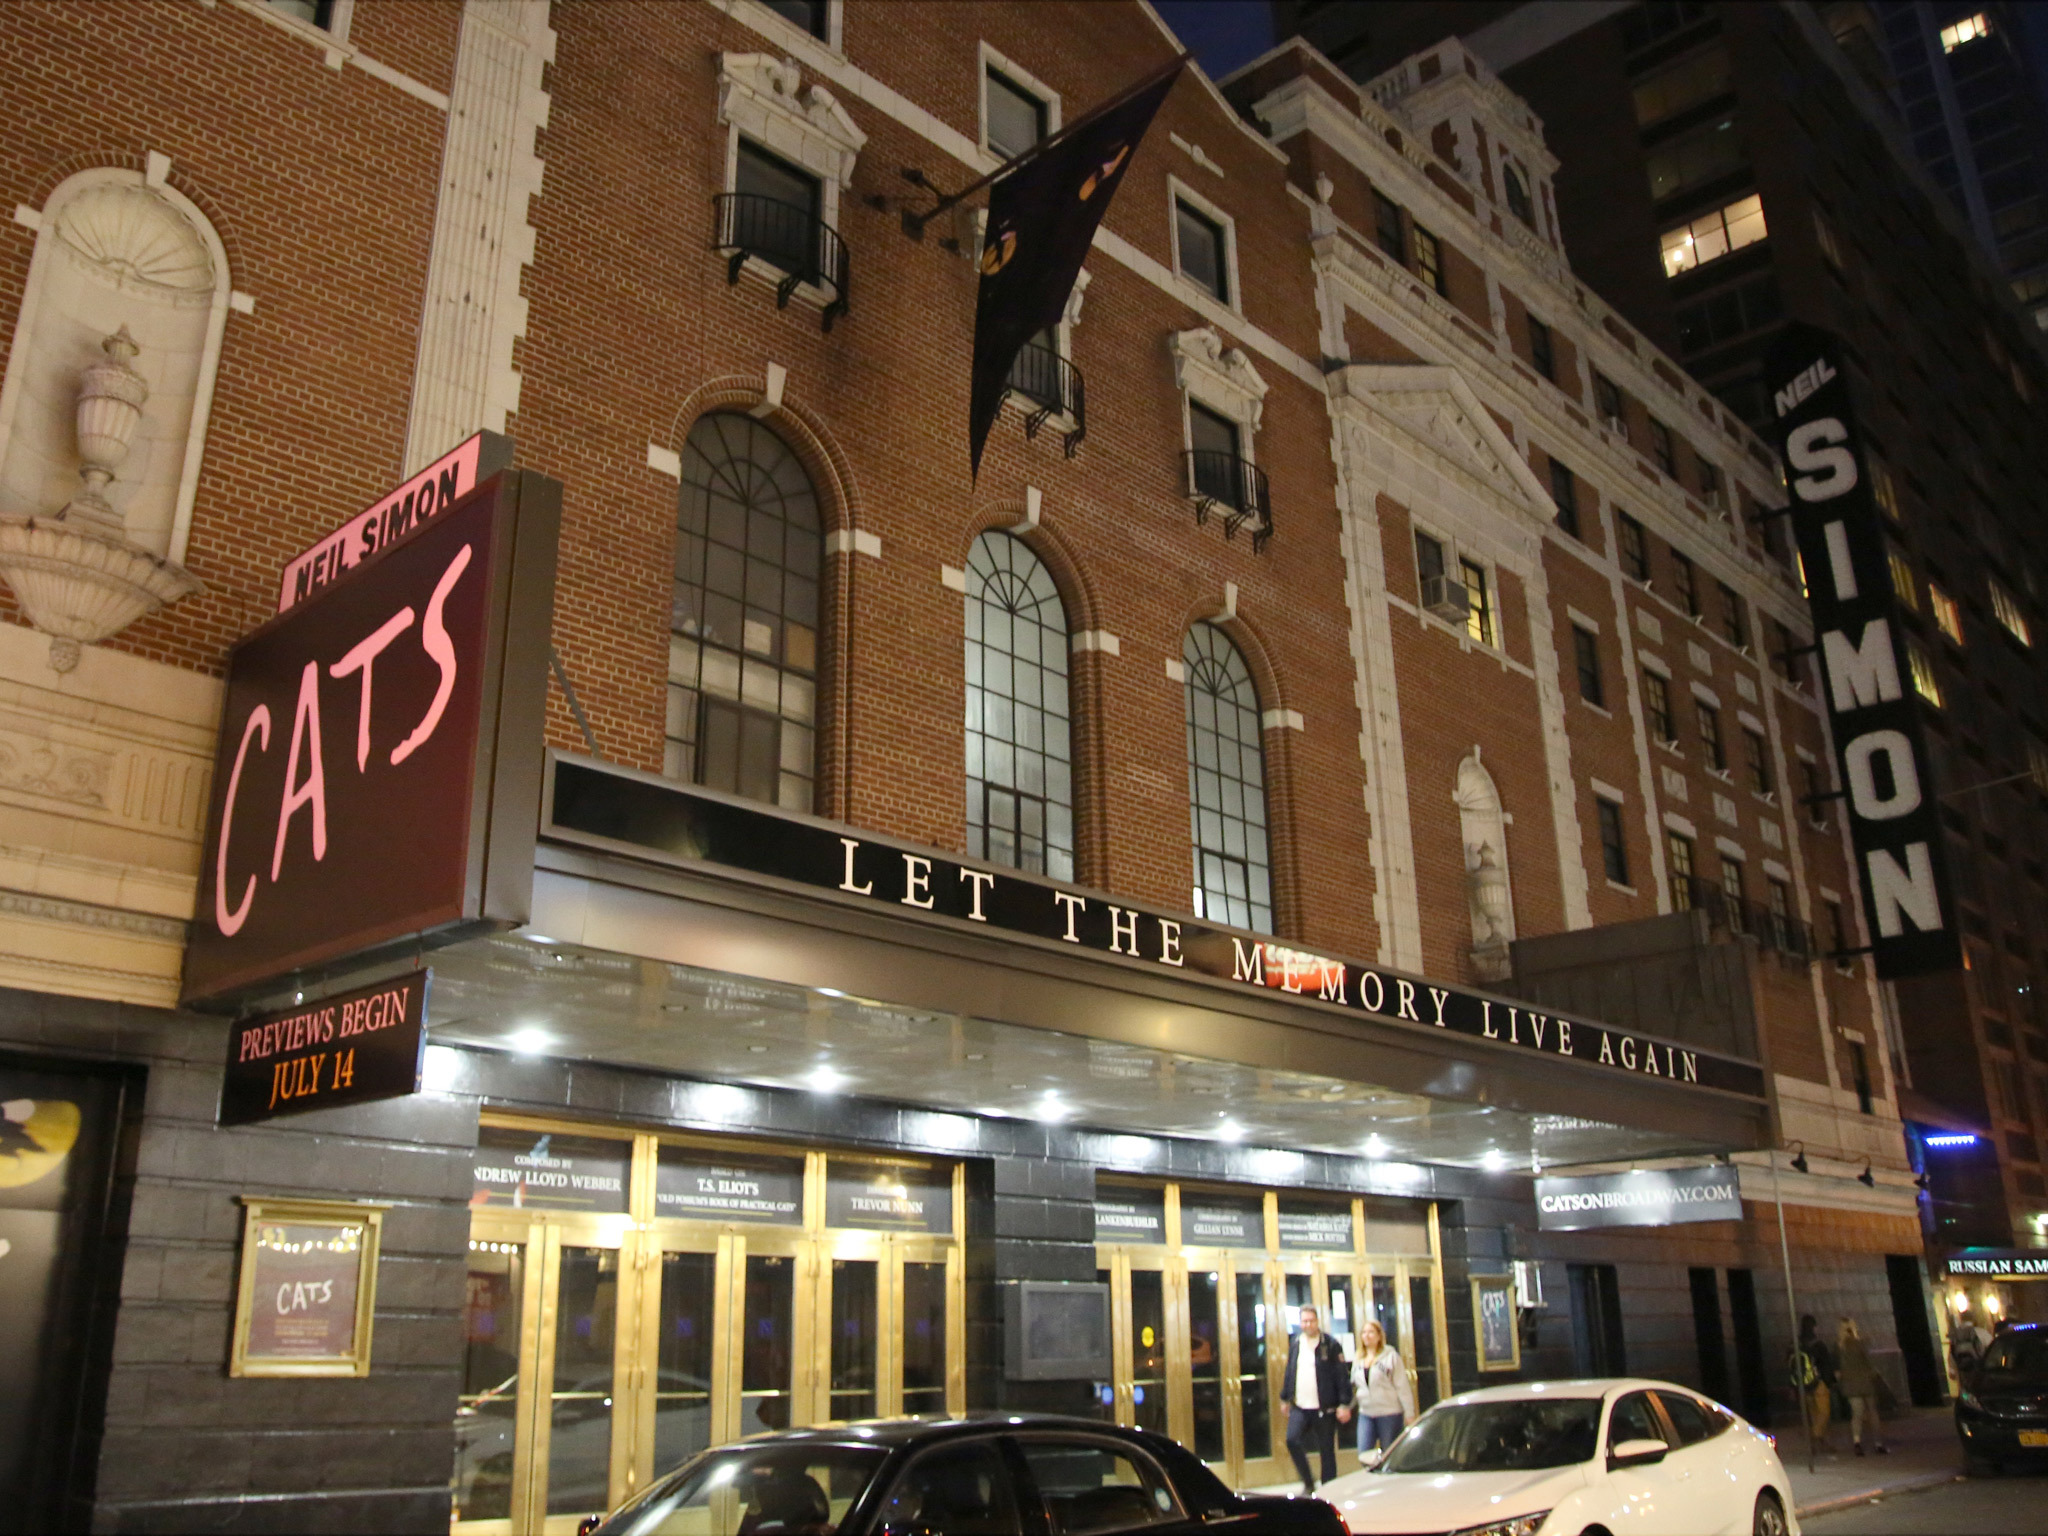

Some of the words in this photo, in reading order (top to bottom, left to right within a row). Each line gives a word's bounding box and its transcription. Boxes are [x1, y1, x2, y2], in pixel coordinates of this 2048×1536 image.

[1774, 357, 1837, 417] NEIL
[294, 538, 350, 601] NEIL
[359, 461, 460, 559] SIMON
[1786, 417, 1944, 939] SIMON
[216, 543, 472, 936] CATS
[839, 838, 994, 922] LET
[1054, 890, 1184, 967] THE
[1232, 937, 1449, 1028] MEMORY
[1482, 1001, 1574, 1056] LIVE
[1599, 1031, 1699, 1084] AGAIN
[239, 1007, 335, 1063] PREVIEWS
[339, 987, 409, 1038] BEGIN
[269, 1053, 326, 1110] JULY
[332, 1048, 355, 1091] 14
[525, 1171, 568, 1188] LLOYD
[571, 1175, 622, 1192] WEBBER
[697, 1178, 716, 1193] T.S.
[719, 1180, 759, 1196] ELIOT'S
[851, 1197, 890, 1212] TREVOR
[893, 1200, 923, 1214] NUNN
[1541, 1184, 1734, 1214] CATSONBROADWAY.COM
[1948, 1259, 2011, 1274] RUSSIAN
[2015, 1259, 2048, 1274] SAM
[277, 1279, 333, 1315] CATS
